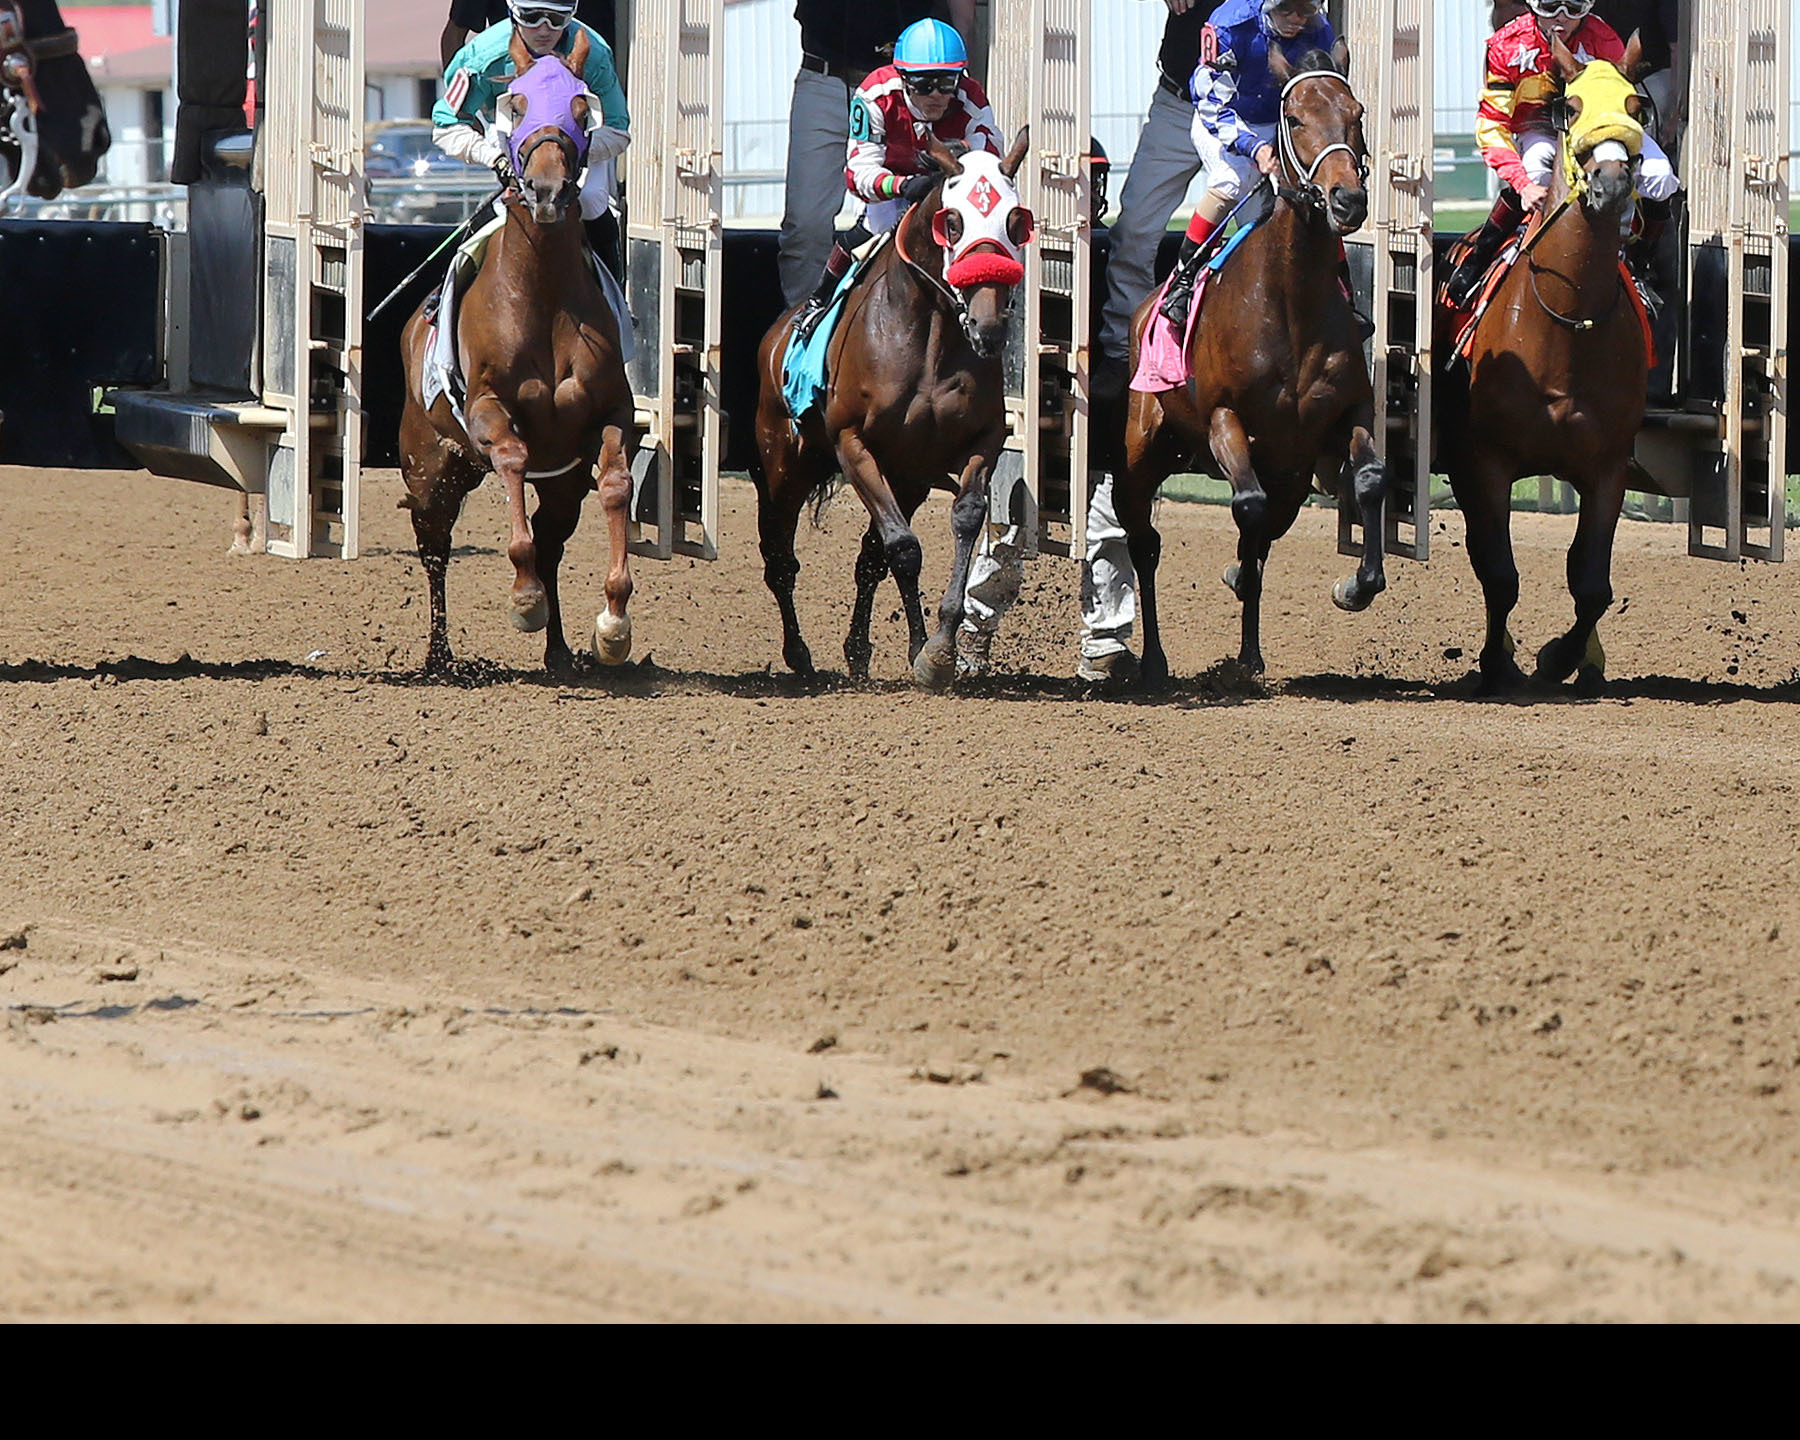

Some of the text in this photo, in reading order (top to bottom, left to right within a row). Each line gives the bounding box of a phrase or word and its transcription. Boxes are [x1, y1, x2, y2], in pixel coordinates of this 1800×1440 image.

[1203, 33, 1213, 65] 8
[445, 72, 466, 108] 11
[852, 104, 865, 136] 9
